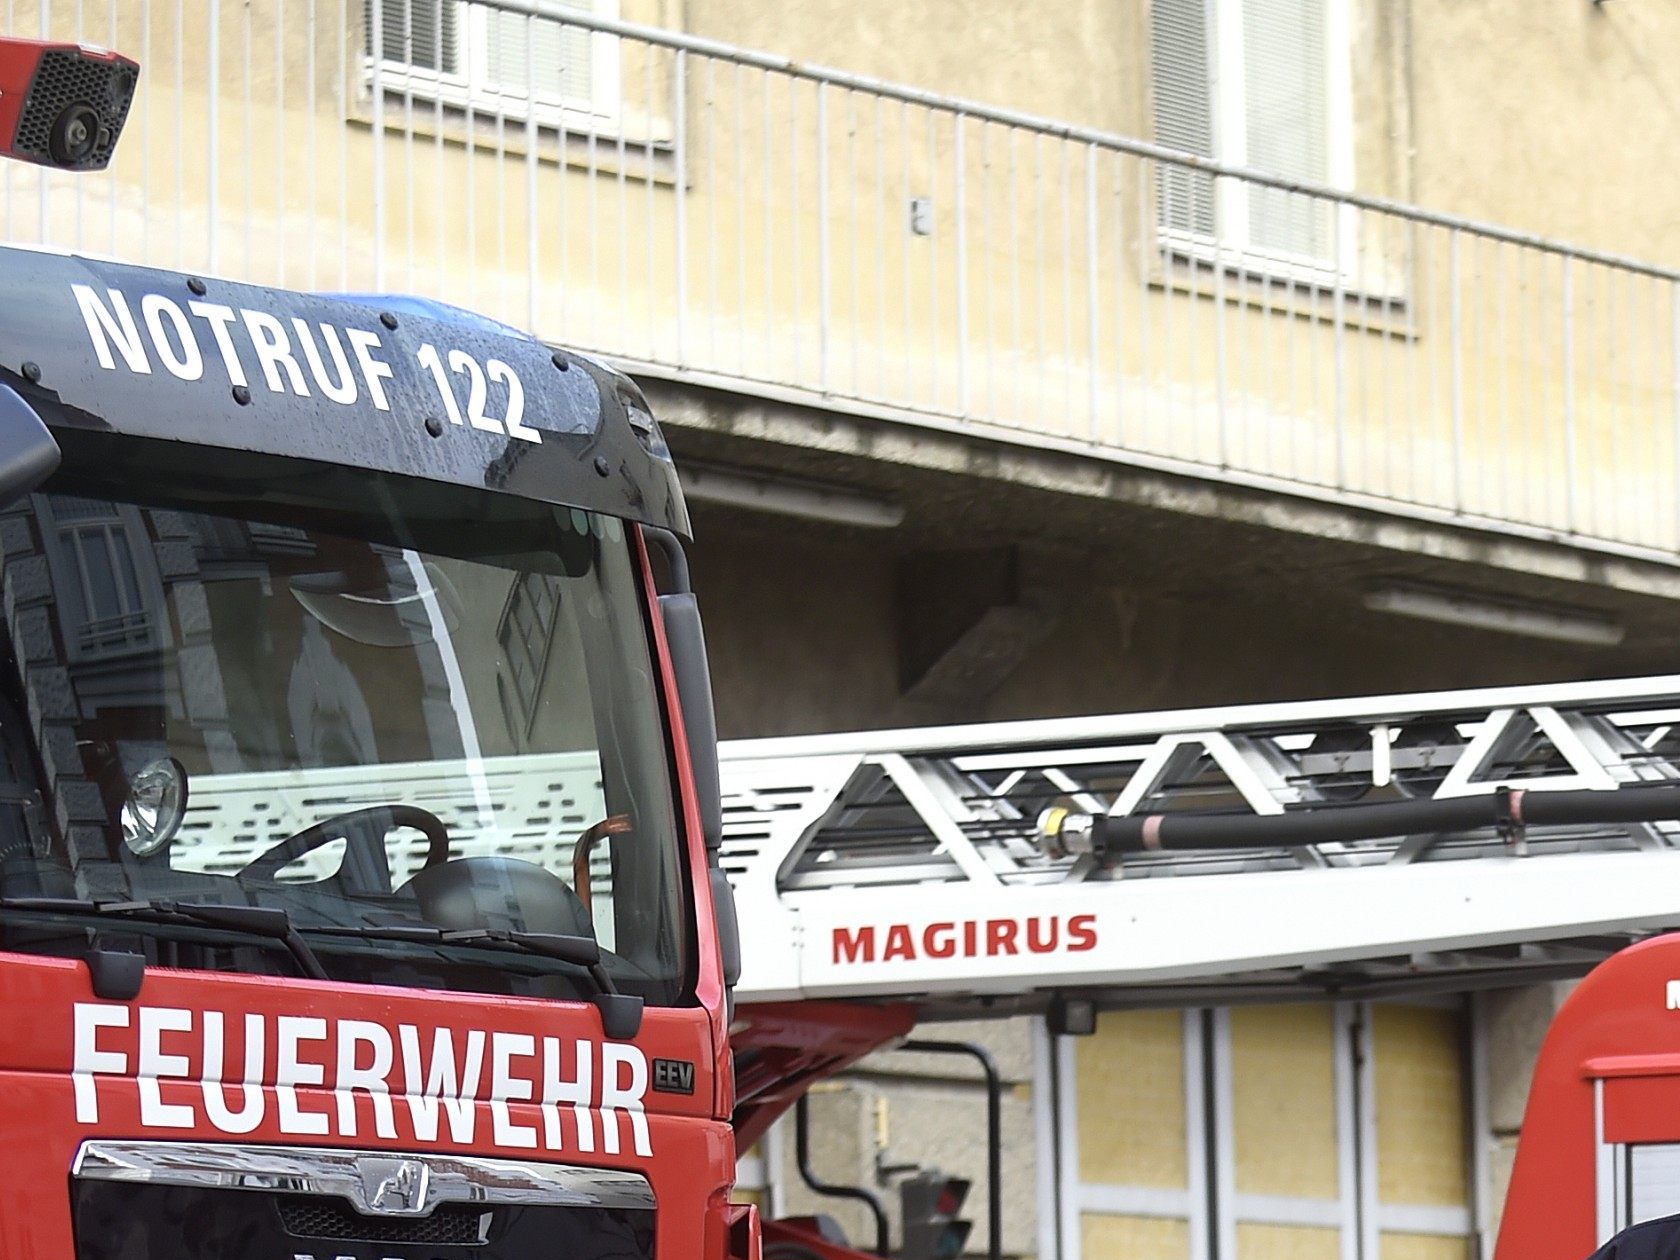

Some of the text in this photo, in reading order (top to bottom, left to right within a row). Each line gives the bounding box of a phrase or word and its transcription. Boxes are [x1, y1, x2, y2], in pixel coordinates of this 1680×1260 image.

[70, 284, 542, 444] NOTRUF 122
[832, 914, 1098, 964] MAGIRUS
[71, 1002, 653, 1157] FEUERWEHR
[655, 1060, 693, 1088] EEV
